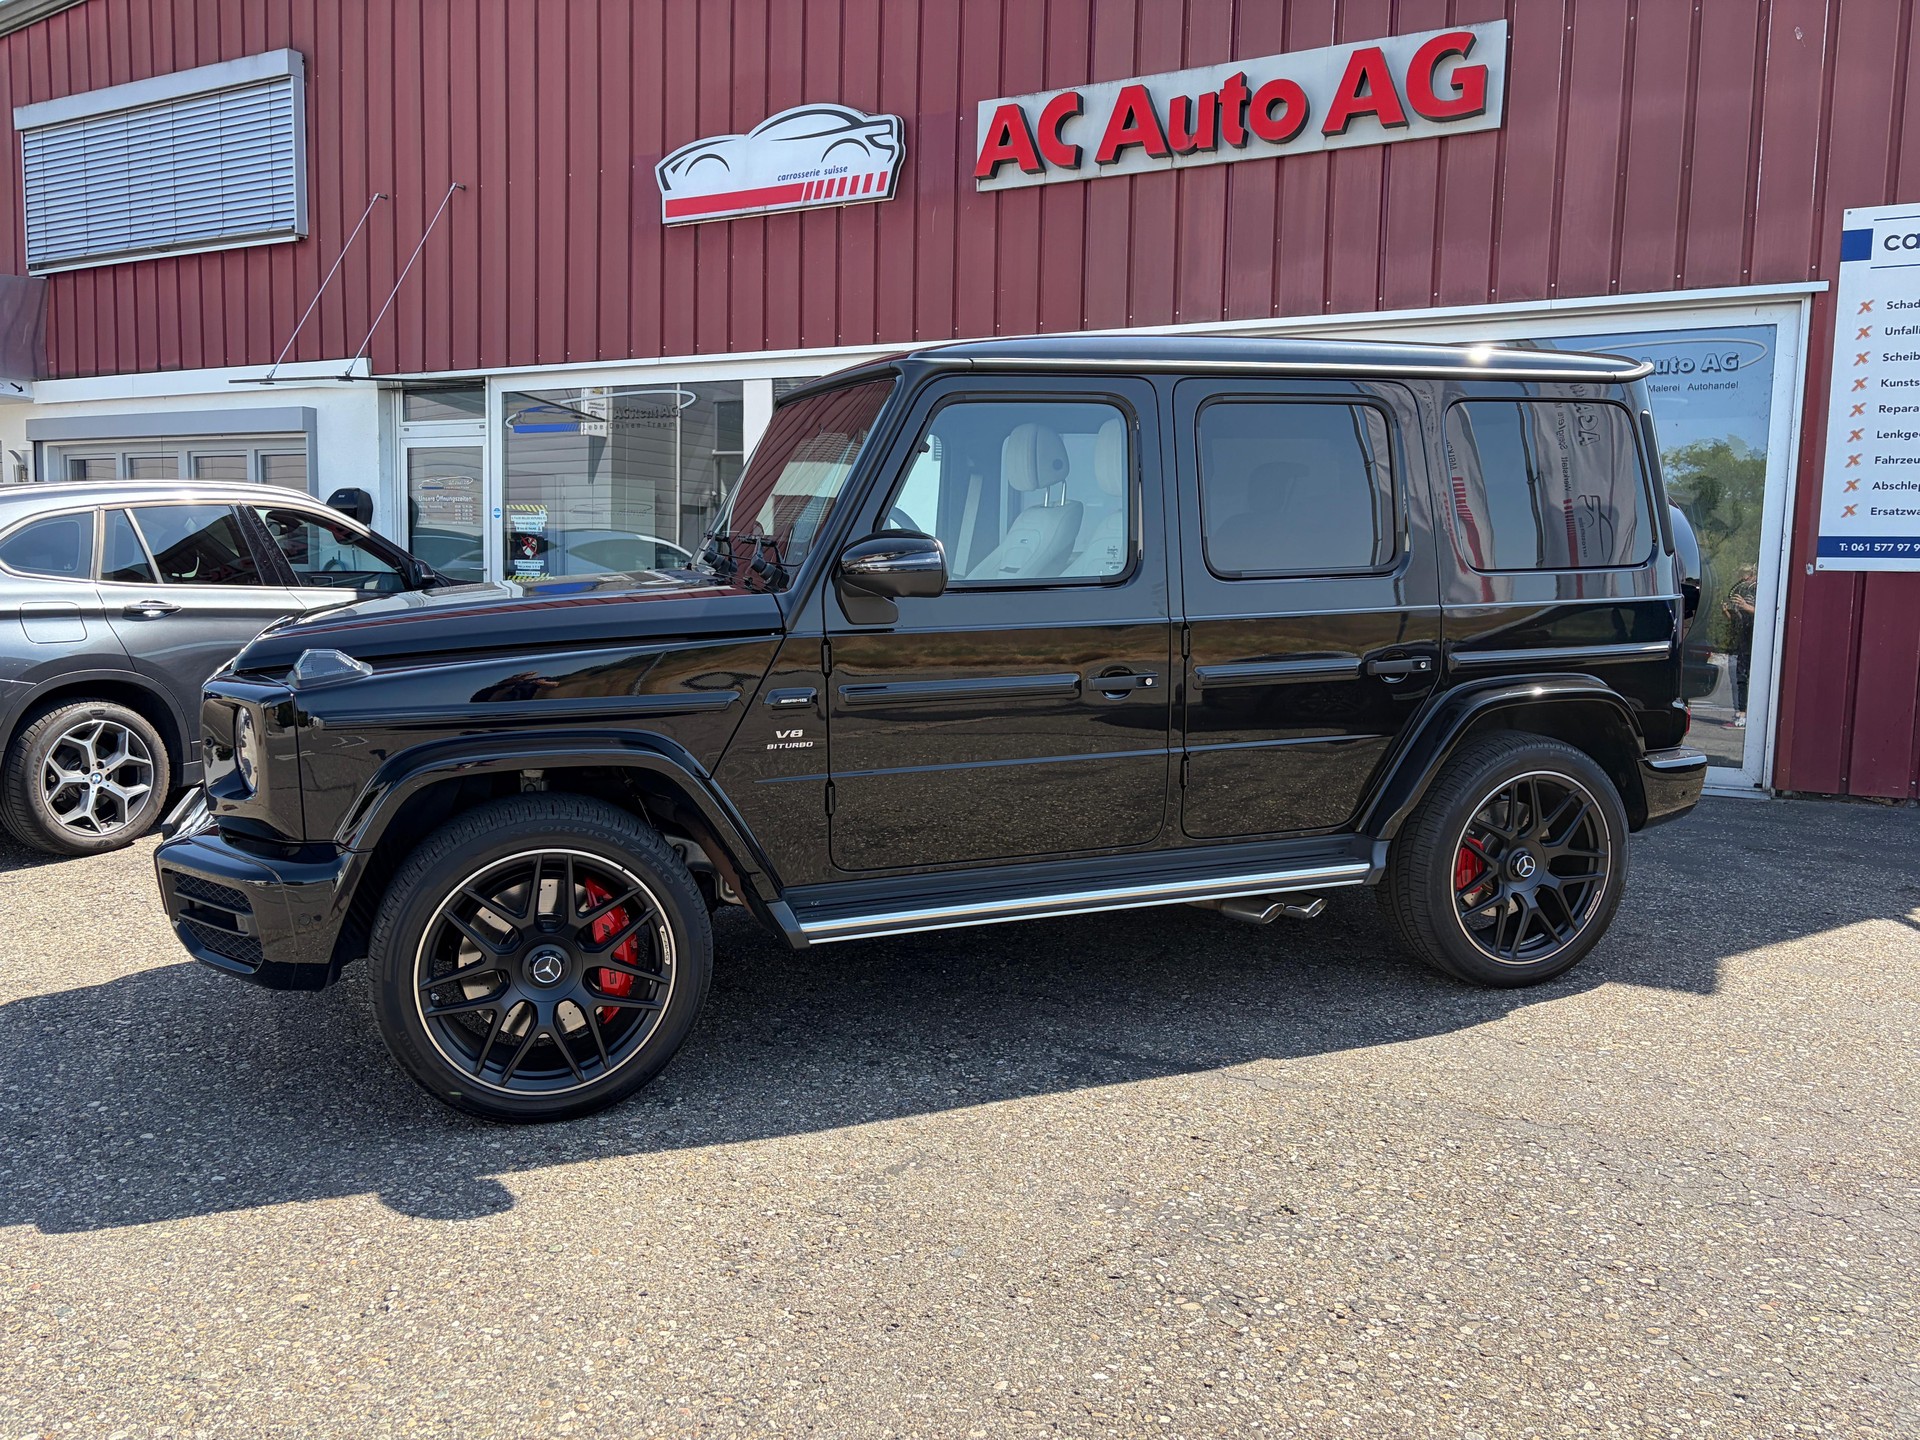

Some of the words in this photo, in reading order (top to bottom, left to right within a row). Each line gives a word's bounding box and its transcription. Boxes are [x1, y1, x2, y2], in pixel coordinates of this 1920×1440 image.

[974, 91, 1083, 180] AC
[1095, 71, 1310, 165] Auto
[1321, 31, 1489, 137] AG
[777, 168, 820, 181] carrosserie
[824, 164, 848, 175] suisse
[1886, 299, 1920, 310] Schad
[1701, 352, 1739, 372] AG
[1882, 351, 1920, 362] Scheib
[1649, 384, 1680, 393] Malerei
[1687, 381, 1739, 391] Autohandel
[1880, 378, 1920, 388] Kunsts
[1878, 404, 1920, 416] Repara
[1876, 429, 1920, 441] Lenkge
[1874, 455, 1920, 465] Fahrzeu
[1839, 543, 1848, 551] T:
[1851, 543, 1870, 551] 061
[1874, 543, 1894, 551] 577
[1896, 543, 1910, 551] 97
[775, 729, 804, 739] V8
[766, 741, 814, 750] BITURBO
[31, 755, 43, 812] GOODYEAR
[510, 824, 626, 847] SCORPION
[630, 848, 674, 885] ZERO
